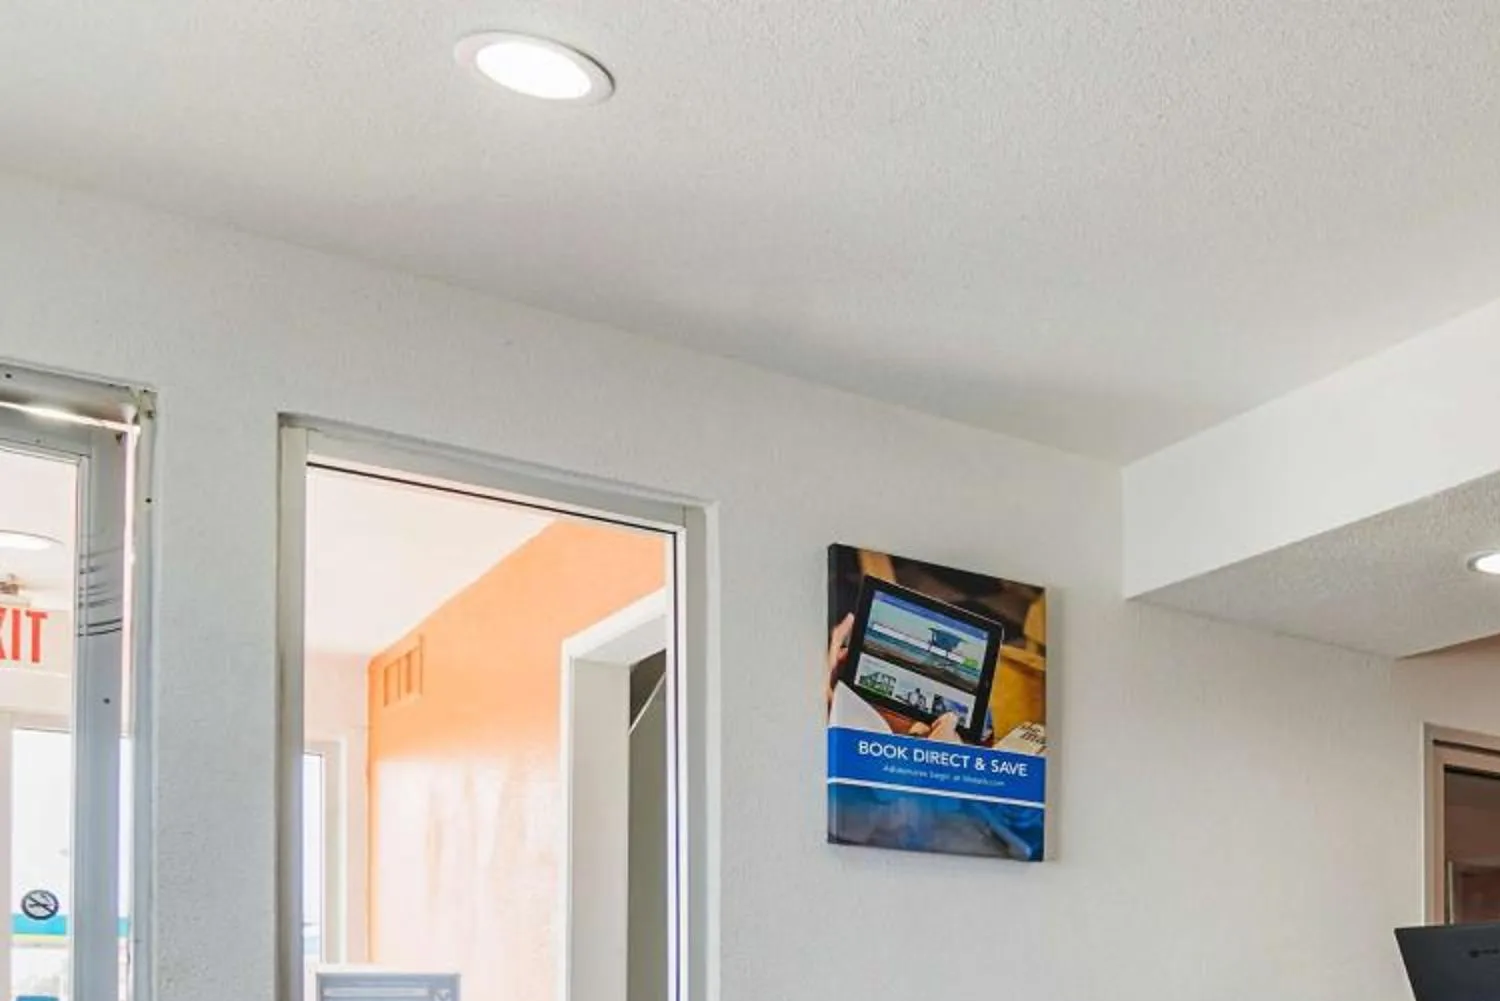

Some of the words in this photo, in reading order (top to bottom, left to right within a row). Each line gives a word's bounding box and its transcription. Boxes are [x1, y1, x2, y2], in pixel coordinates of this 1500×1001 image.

[858, 740, 909, 761] BOOK
[912, 748, 971, 769] DIRECT
[974, 756, 986, 771] &
[990, 758, 1029, 777] SAVE
